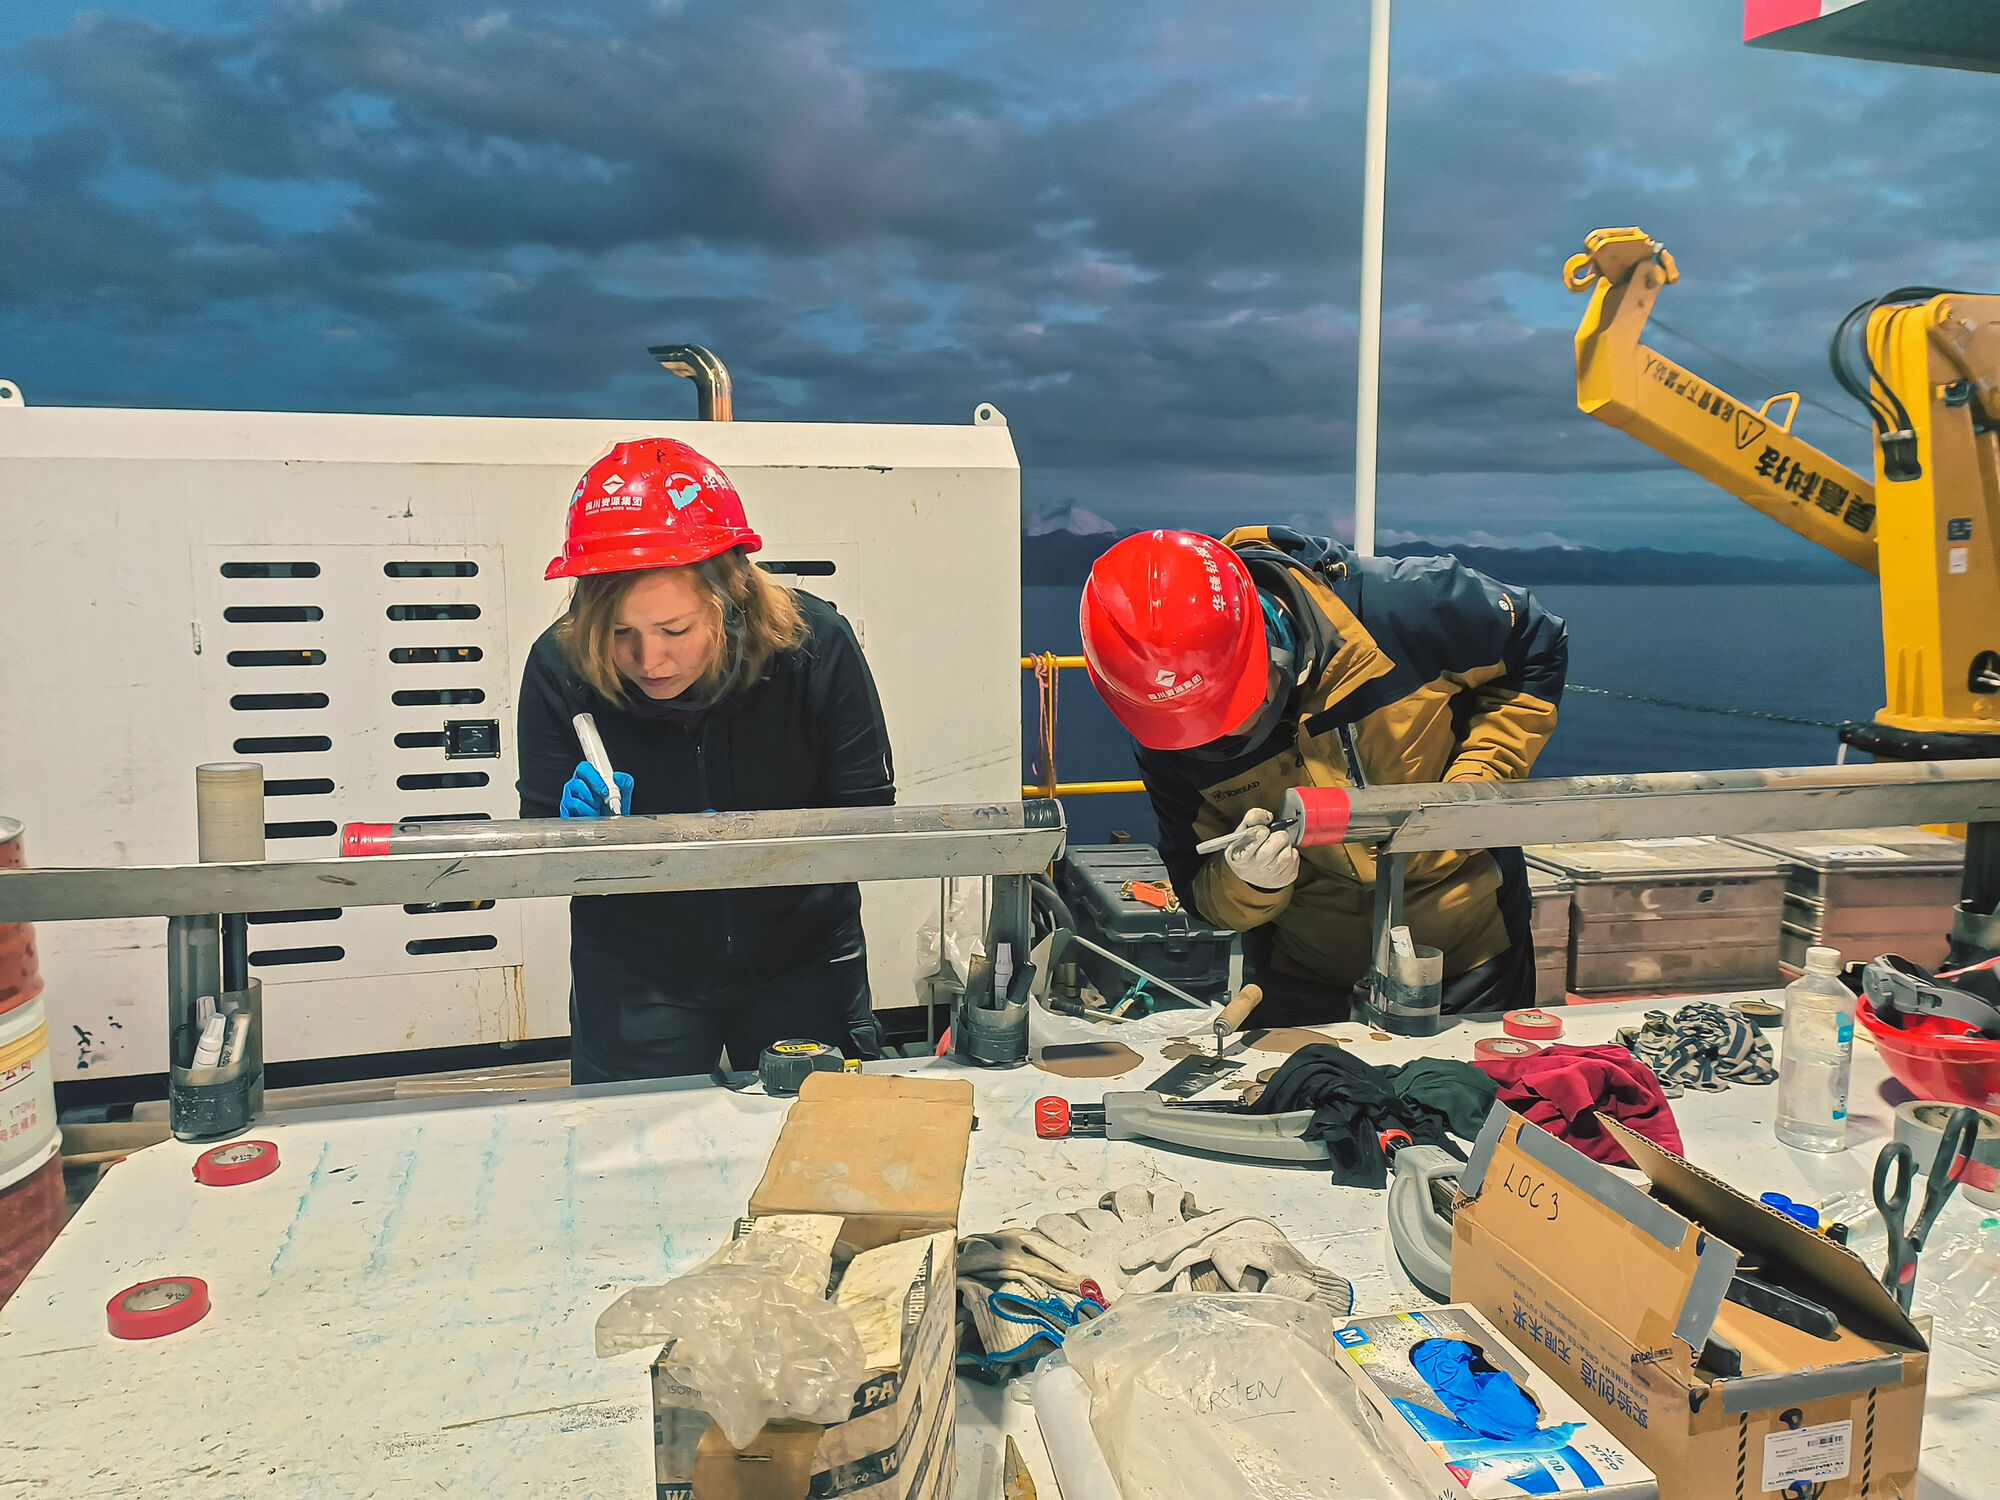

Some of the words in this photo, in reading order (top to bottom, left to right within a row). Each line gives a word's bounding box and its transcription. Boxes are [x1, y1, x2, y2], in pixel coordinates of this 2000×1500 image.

[585, 495, 643, 511] 四川资源集团
[1338, 1329, 1364, 1344] M
[1512, 1301, 1571, 1366] 无限未来
[1580, 1357, 1649, 1430] 实验创造
[1601, 1363, 1649, 1405] EXPERIMENT
[1589, 1444, 1620, 1472] INTCO
